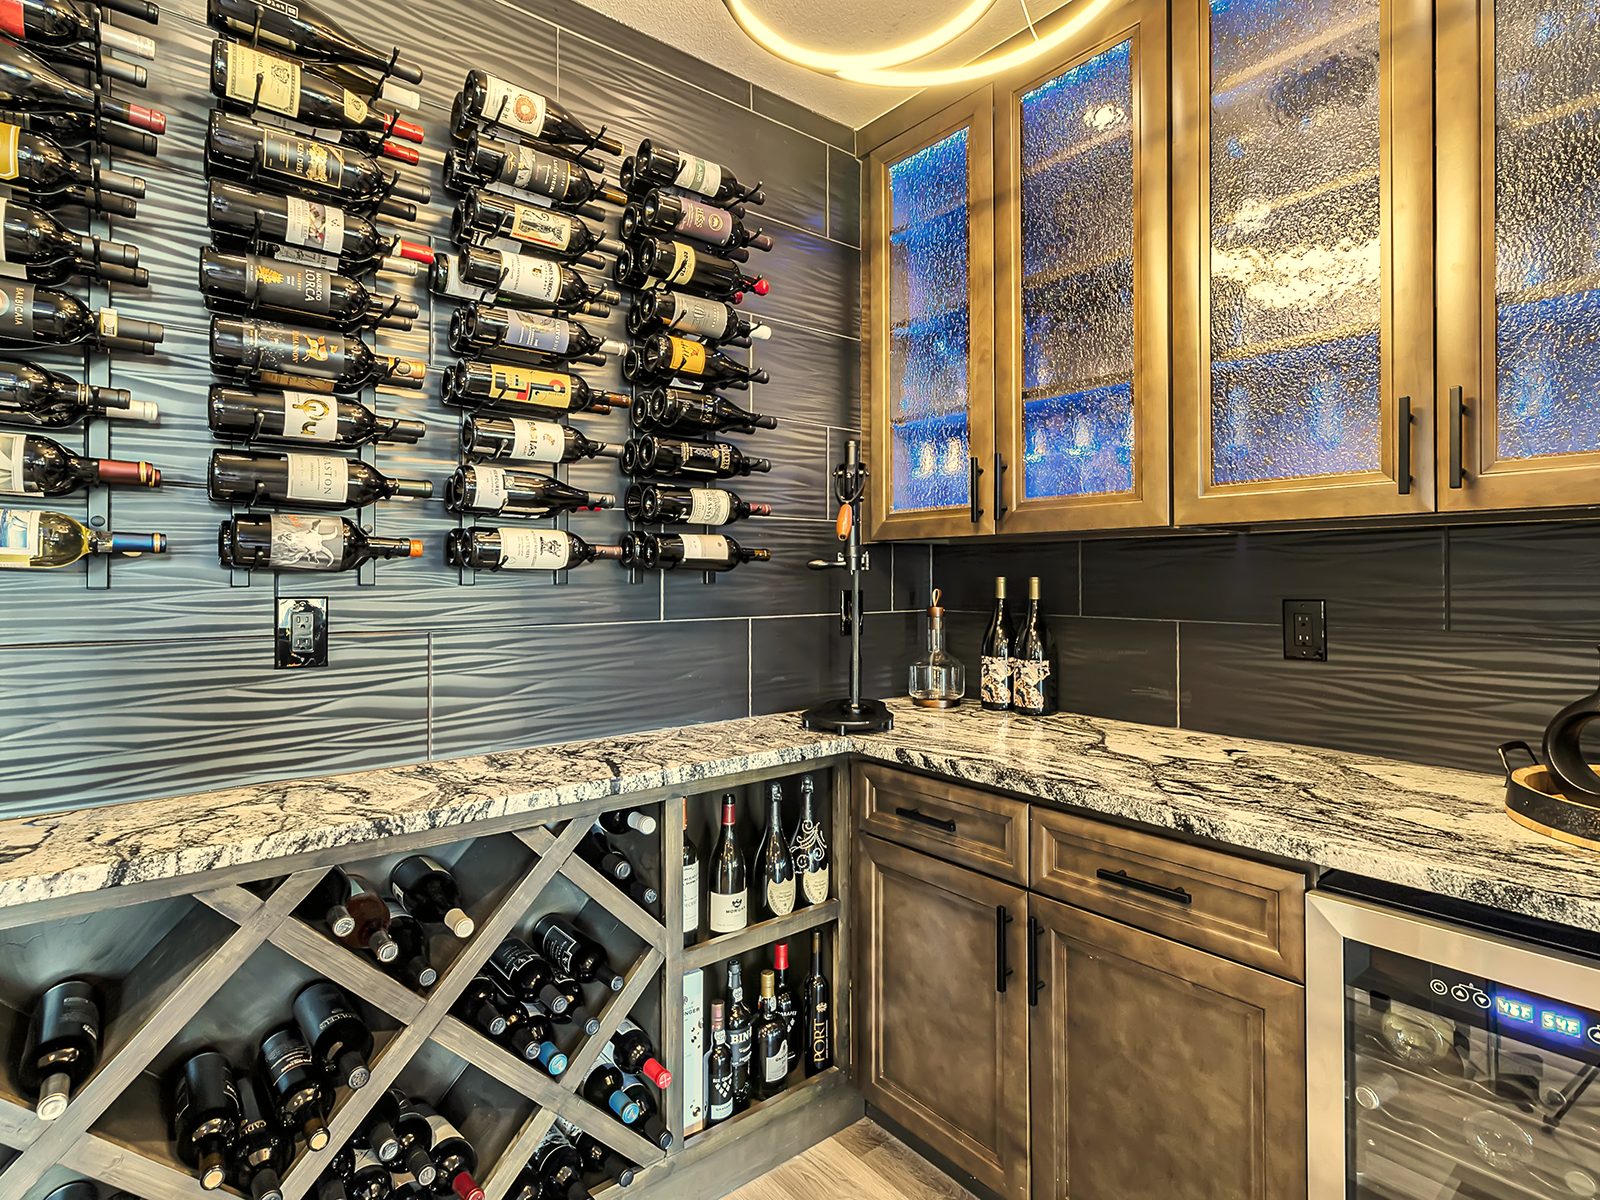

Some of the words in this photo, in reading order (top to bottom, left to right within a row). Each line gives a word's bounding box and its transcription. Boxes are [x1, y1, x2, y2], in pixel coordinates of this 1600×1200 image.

[297, 141, 305, 157] KEN
[295, 157, 304, 174] DEIS
[695, 207, 706, 229] HESS
[305, 269, 316, 302] LORCA
[315, 272, 323, 302] MAURICIO
[15, 287, 25, 326] BARBICAIA
[684, 1007, 700, 1016] NGER
[730, 1030, 751, 1045] BIN
[813, 1018, 826, 1064] PORT
